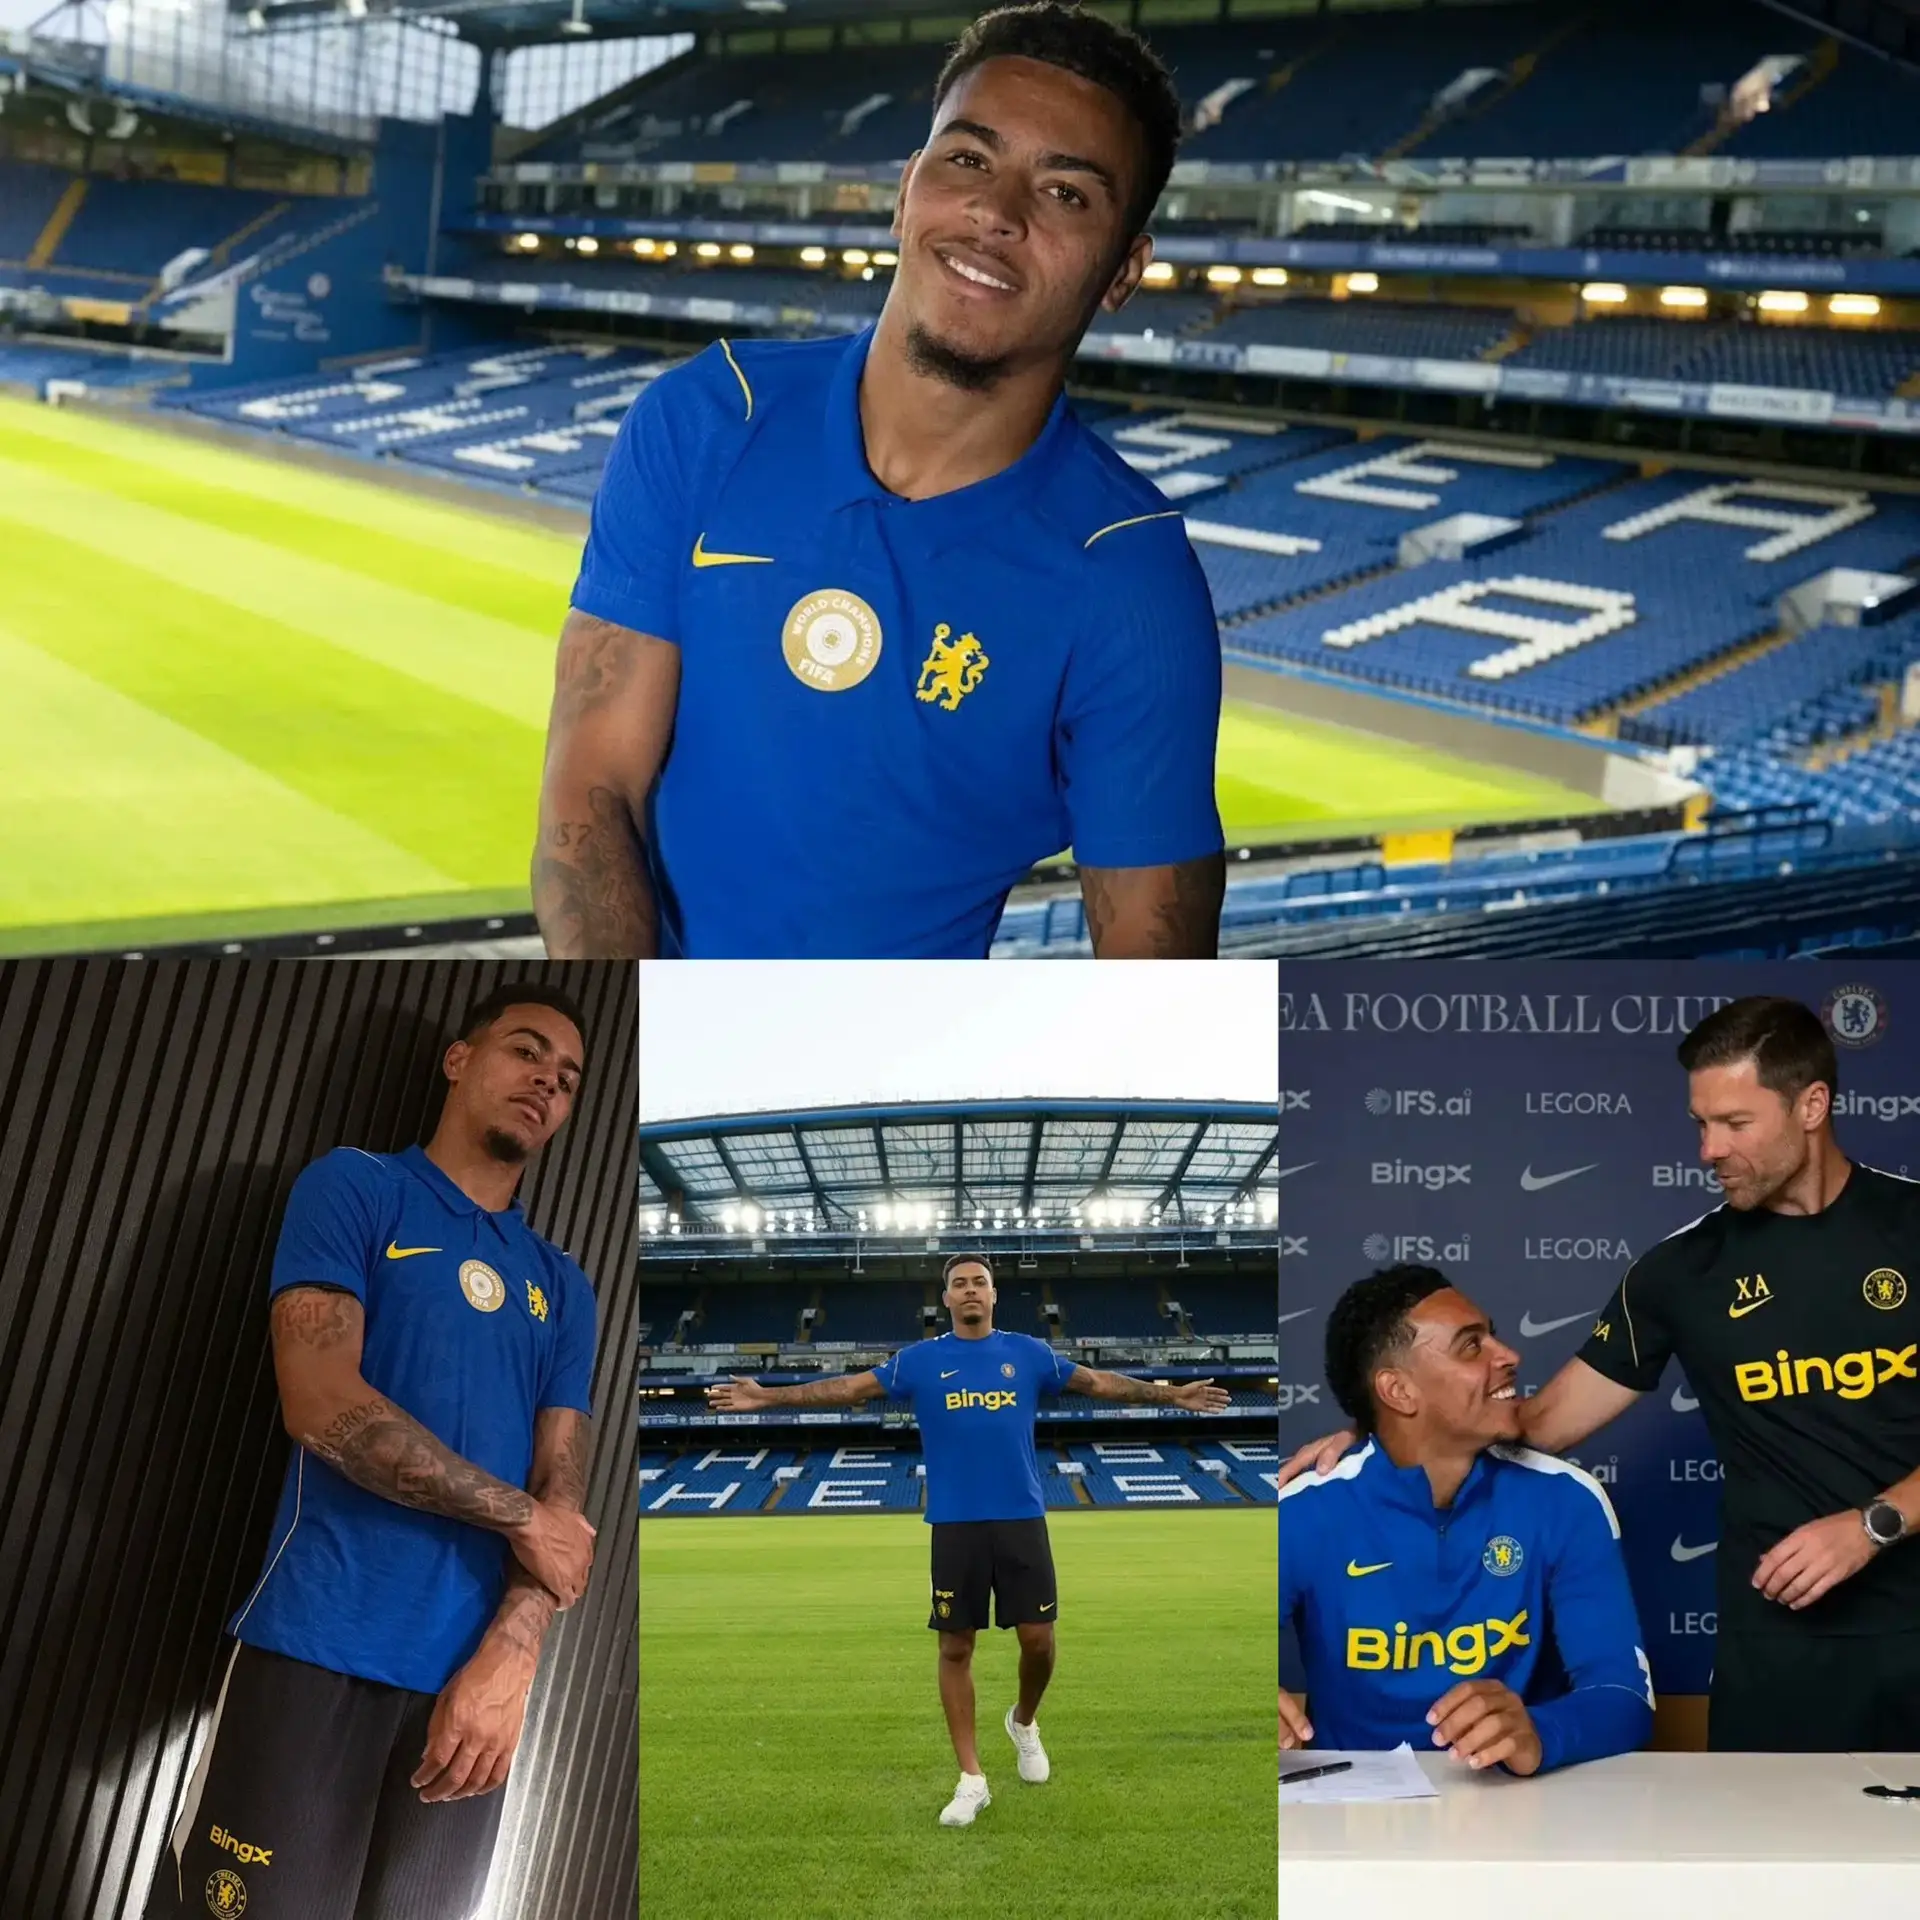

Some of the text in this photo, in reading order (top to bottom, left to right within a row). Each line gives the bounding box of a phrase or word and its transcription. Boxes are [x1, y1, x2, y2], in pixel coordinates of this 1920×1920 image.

[792, 597, 873, 666] WORLD CHAMPIONS
[798, 658, 836, 685] FIFA
[1343, 993, 1600, 1034] FOOTBALL
[1396, 1088, 1472, 1116] IFS.ai
[1526, 1092, 1632, 1115] LEGORA
[1394, 1234, 1471, 1262] IFS.ai
[1525, 1238, 1632, 1260] LEGORA
[1735, 1273, 1770, 1301] XA
[471, 1295, 489, 1308] FIFA
[1670, 1459, 1726, 1482] LEG
